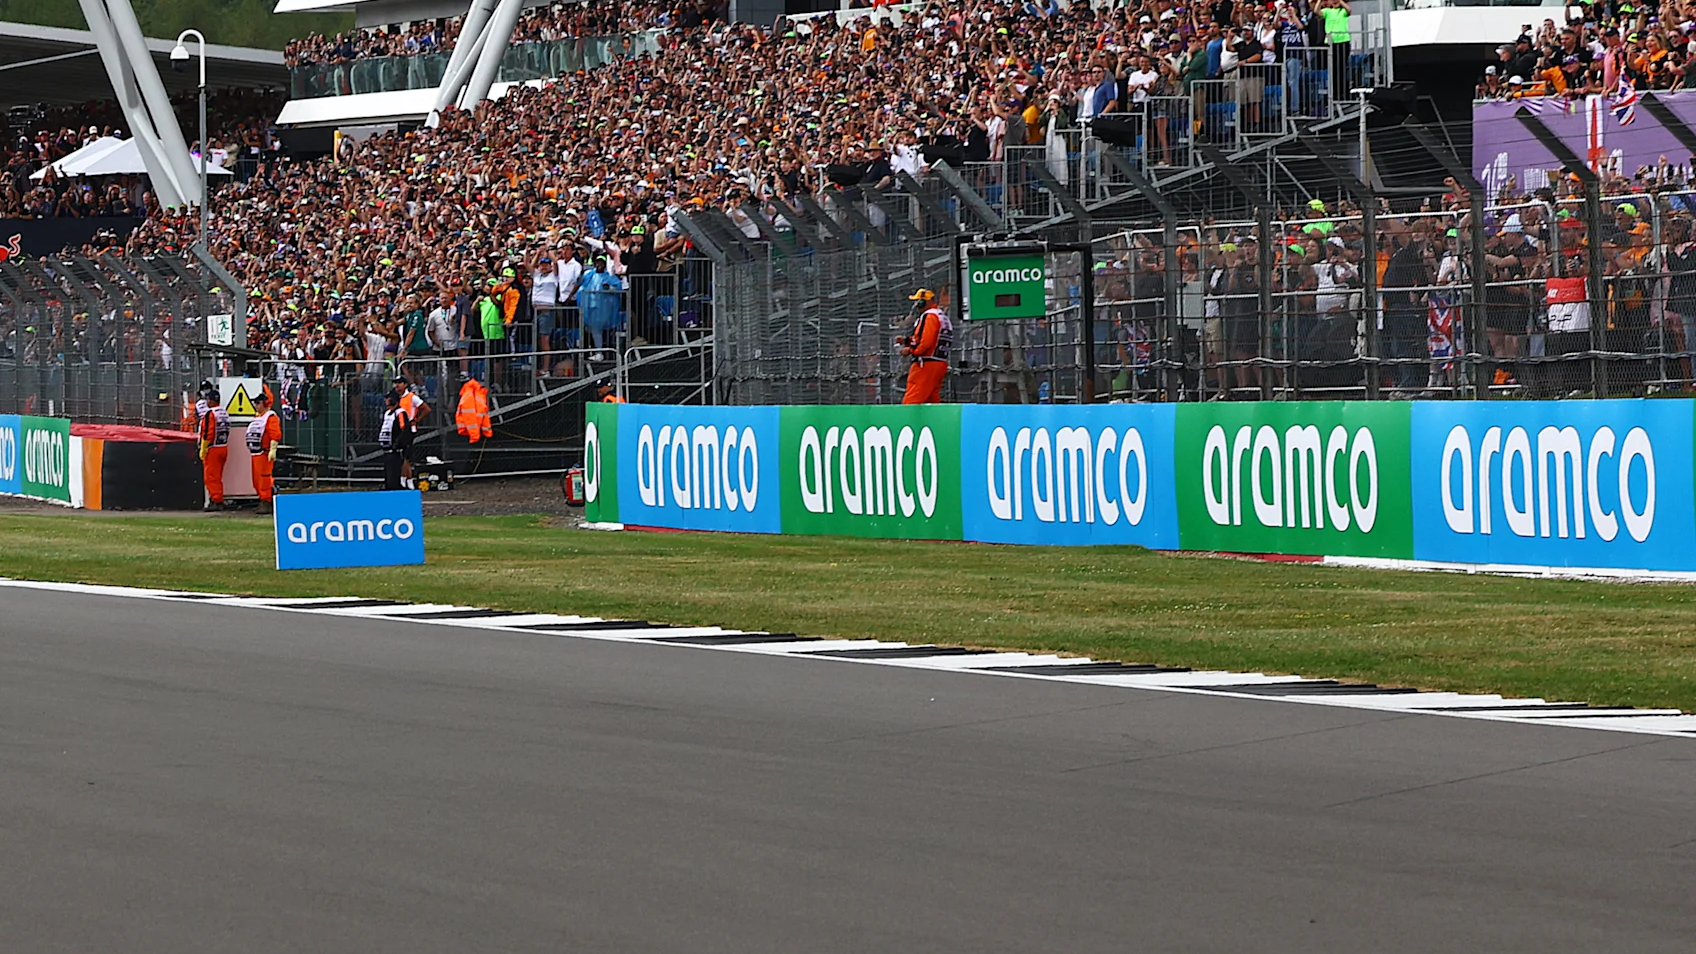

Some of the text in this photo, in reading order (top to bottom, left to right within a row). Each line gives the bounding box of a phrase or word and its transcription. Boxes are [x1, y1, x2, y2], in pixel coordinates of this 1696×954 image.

[973, 268, 1042, 283] aramco
[638, 424, 759, 512] aramco
[799, 425, 938, 518] aramco
[987, 426, 1147, 526] aramco
[1203, 424, 1378, 533] aramco
[1441, 425, 1655, 542] aramco
[287, 518, 414, 543] aramco
